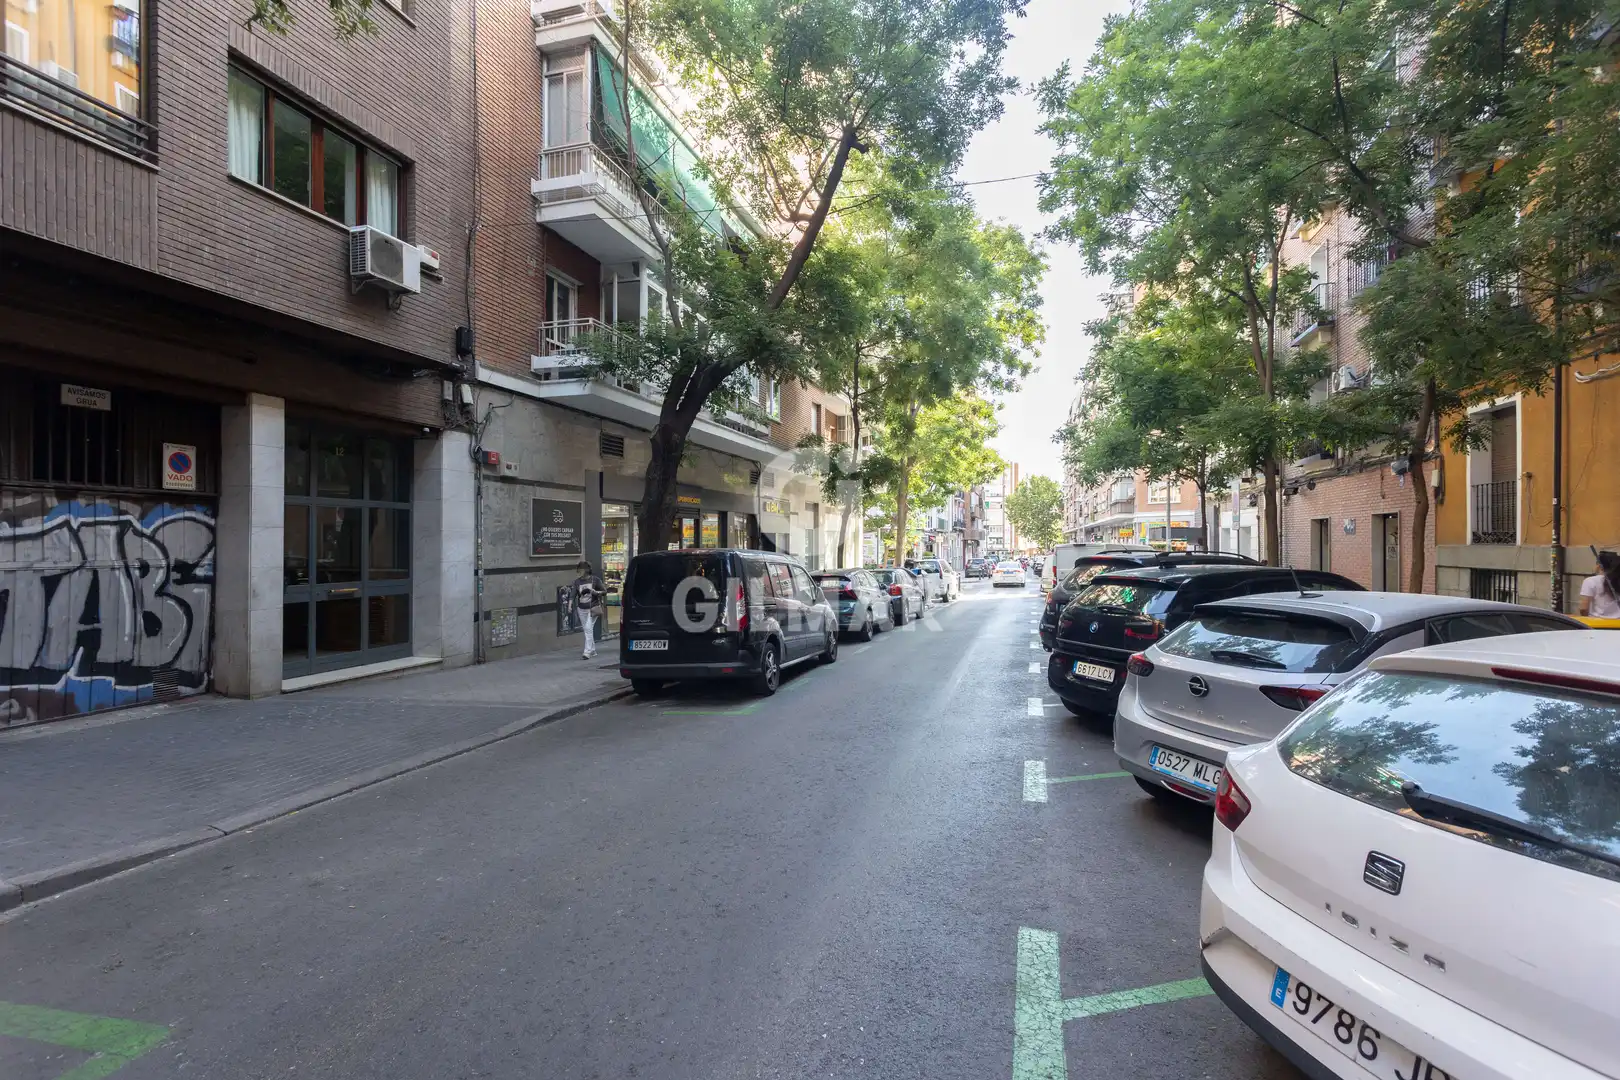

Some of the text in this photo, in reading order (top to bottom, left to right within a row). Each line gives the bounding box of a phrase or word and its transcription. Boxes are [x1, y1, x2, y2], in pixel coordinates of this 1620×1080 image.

[67, 387, 106, 399] AVISAMOS
[76, 397, 97, 406] GRUA
[167, 473, 193, 481] VADO
[634, 641, 651, 649] 8522
[1077, 664, 1113, 680] 6617 LCX
[1158, 751, 1190, 773] 0527
[1325, 902, 1446, 973] IBIZA
[1292, 982, 1381, 1061] 9786
